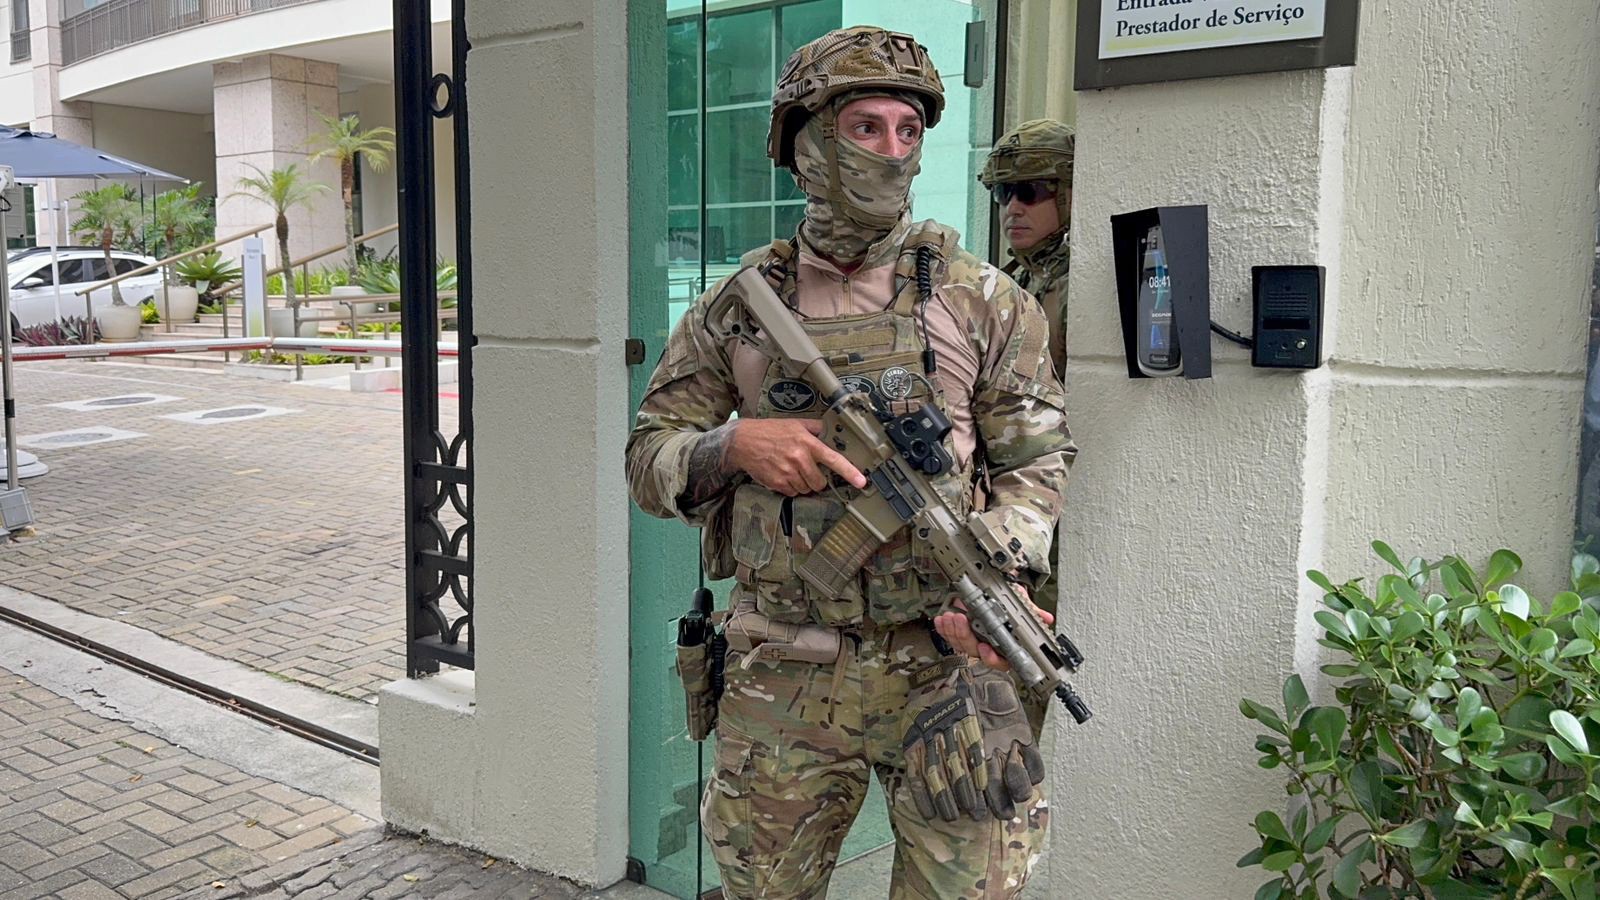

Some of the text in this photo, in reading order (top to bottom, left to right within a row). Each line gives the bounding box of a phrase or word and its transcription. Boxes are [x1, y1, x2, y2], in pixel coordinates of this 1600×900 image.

[1116, 0, 1192, 11] Entra
[1115, 3, 1304, 37] Prestador de Serviço
[1148, 275, 1171, 288] 08:41
